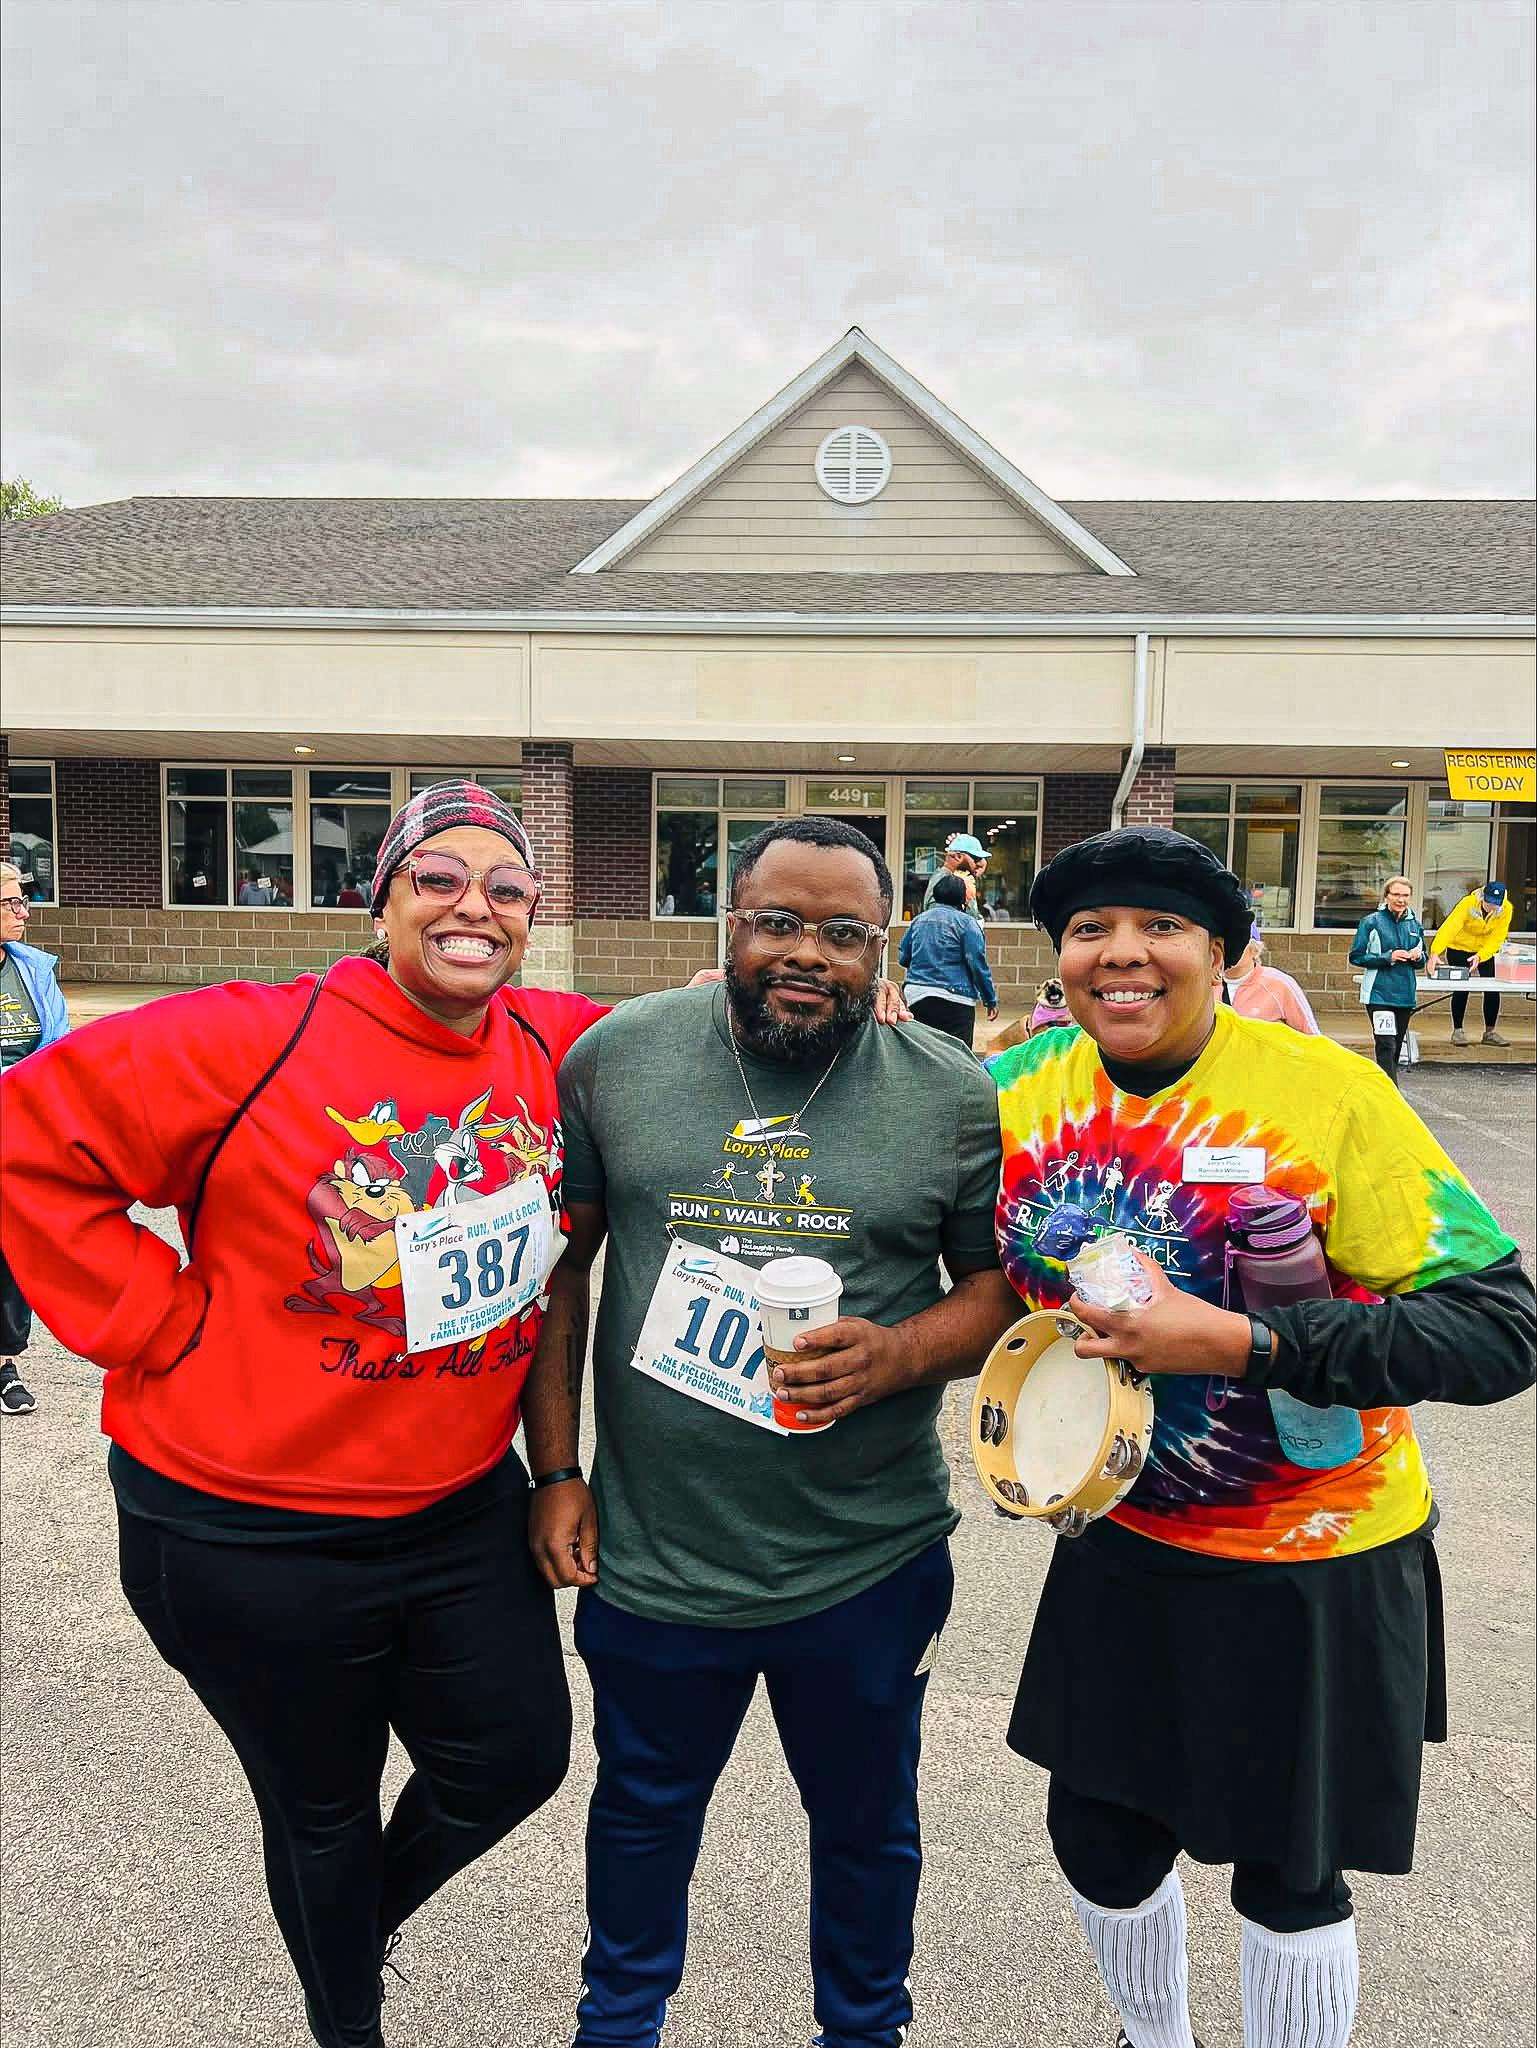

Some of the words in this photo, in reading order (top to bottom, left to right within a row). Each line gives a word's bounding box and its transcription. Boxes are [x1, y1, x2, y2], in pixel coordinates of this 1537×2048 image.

[1447, 754, 1536, 769] REGISTERING
[1465, 775, 1524, 791] TODAY
[723, 1138, 767, 1159] Lory's
[772, 1144, 811, 1159] Place
[493, 1212, 515, 1231] WALK
[522, 1199, 542, 1218] ROCK
[670, 1202, 709, 1219] RUN
[725, 1207, 782, 1227] WALK
[797, 1213, 851, 1231] ROCK
[409, 1240, 438, 1254] Lory's
[440, 1233, 464, 1247] Place
[438, 1223, 530, 1310] 387
[671, 1266, 696, 1284] Lory's
[696, 1277, 721, 1295] Place
[430, 1325, 467, 1342] FAMILY
[470, 1301, 516, 1332] FOUNDATION
[437, 1318, 457, 1331] THE
[460, 1295, 512, 1322] MCLOUGHLIN
[320, 1337, 424, 1380] That's
[436, 1343, 486, 1379] All
[661, 1353, 679, 1369] THE
[680, 1362, 742, 1396] MCLOUGHLIN
[651, 1359, 682, 1381] FAMILY
[685, 1375, 746, 1409] FOUNDATION
